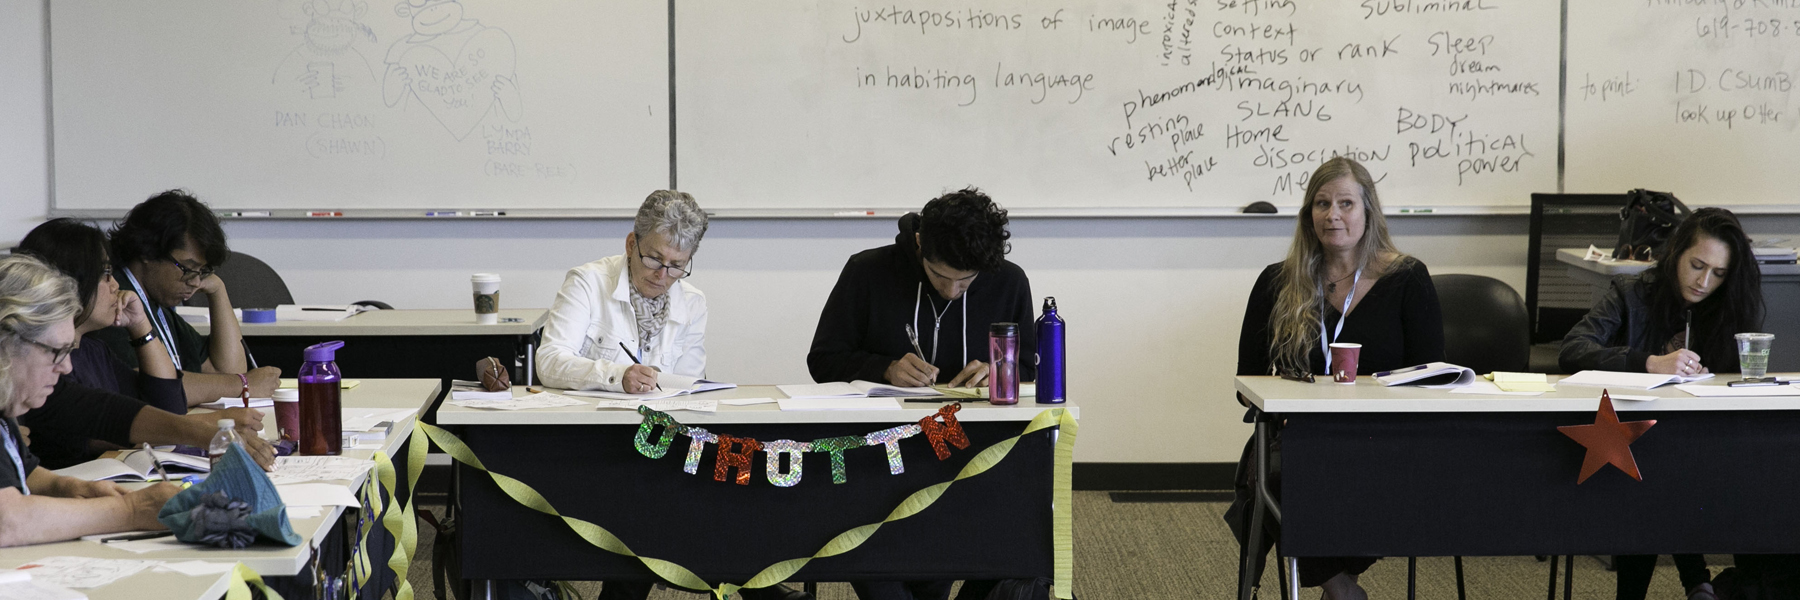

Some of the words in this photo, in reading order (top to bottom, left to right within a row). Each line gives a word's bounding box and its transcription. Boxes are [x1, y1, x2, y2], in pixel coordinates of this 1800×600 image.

[842, 6, 1021, 43] juxtapositions
[1041, 9, 1064, 30] of
[1089, 15, 1152, 44] image
[415, 64, 439, 80] WE
[443, 66, 467, 83] ARE
[469, 48, 485, 66] SO
[1300, 47, 1323, 62] or
[1450, 54, 1501, 77] dream
[1449, 79, 1540, 101] nightmares
[1580, 73, 1597, 101] to
[275, 110, 306, 127] DAN
[1397, 107, 1468, 142] BODY
[1717, 109, 1737, 130] up
[1107, 113, 1189, 156] resting
[1226, 124, 1289, 149] Home
[1145, 150, 1194, 182] better
[1458, 154, 1530, 186] power
